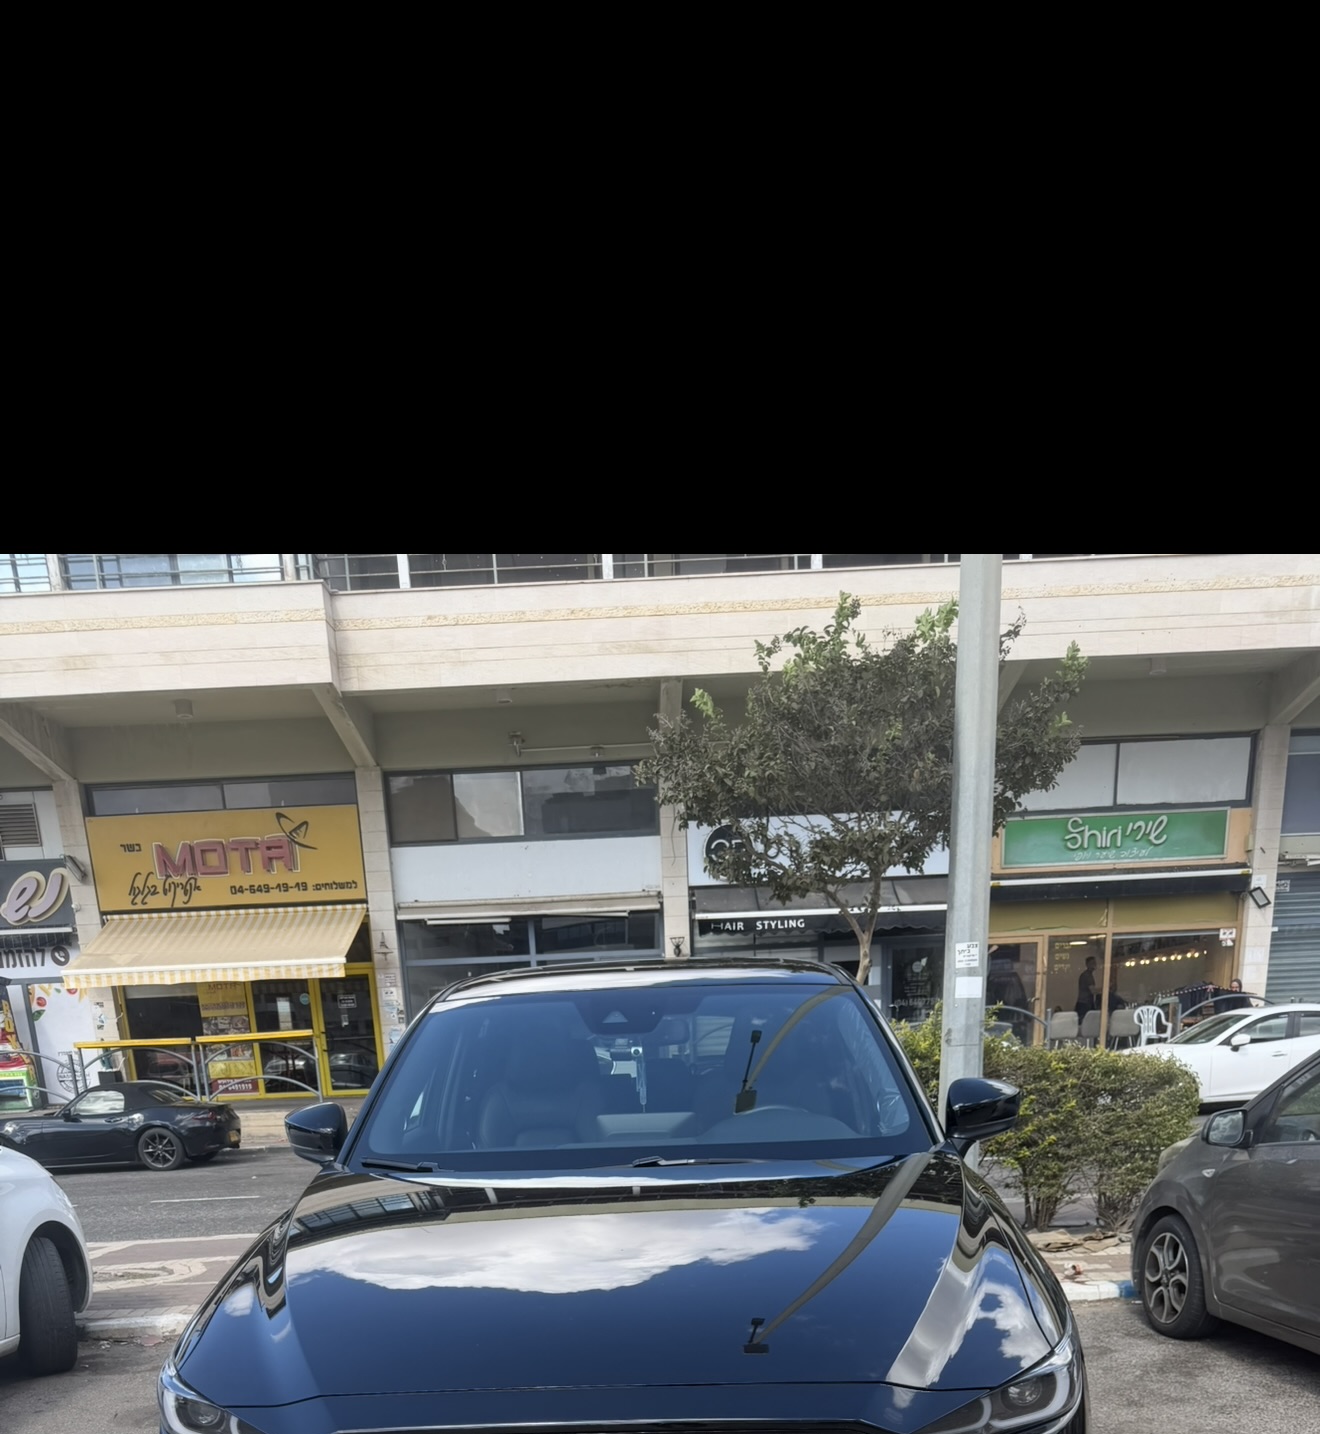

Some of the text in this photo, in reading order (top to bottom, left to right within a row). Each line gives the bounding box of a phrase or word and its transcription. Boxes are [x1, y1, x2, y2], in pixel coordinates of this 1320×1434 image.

[1064, 817, 1122, 850] Shiri
[1126, 814, 1168, 845] שירי
[153, 833, 300, 879] MOTA
[230, 880, 358, 896] למשלוחים: 04-649-19-19
[711, 918, 805, 931] HAIR STYLING
